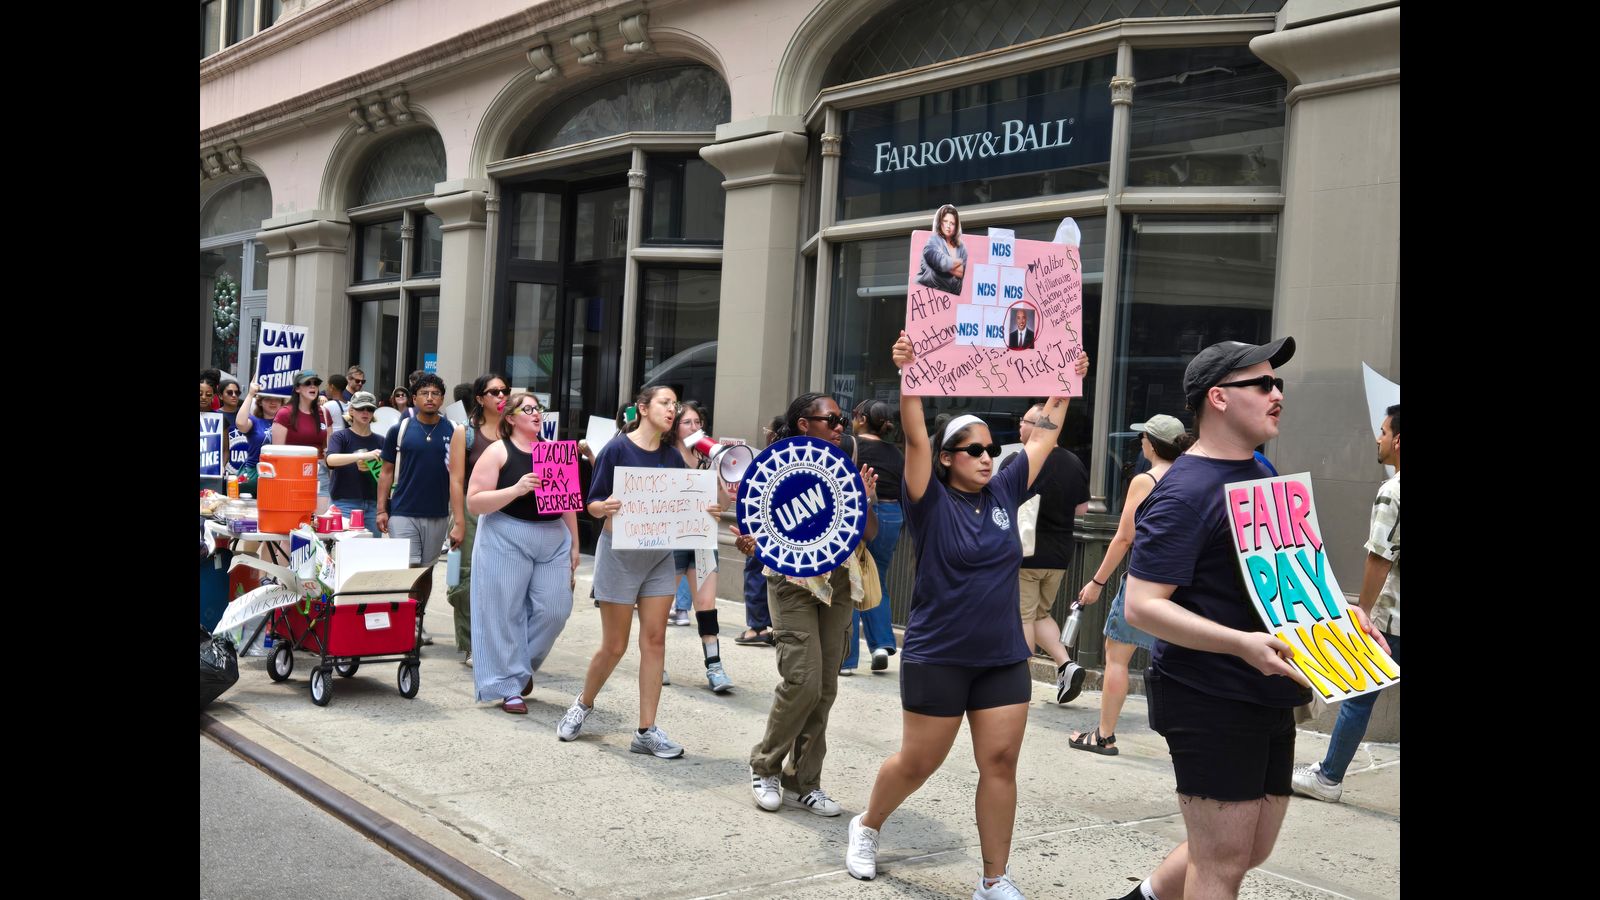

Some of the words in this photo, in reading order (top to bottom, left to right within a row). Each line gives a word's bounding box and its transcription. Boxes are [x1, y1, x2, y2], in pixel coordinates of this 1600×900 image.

[991, 242, 1011, 257] NDS
[1033, 254, 1064, 280] Malibu
[977, 282, 996, 297] NDS
[1004, 285, 1023, 299] NDS
[1036, 273, 1072, 295] Millionaire
[911, 289, 927, 321] At
[925, 287, 951, 315] the
[1040, 291, 1062, 308] taking
[1043, 303, 1062, 318] union
[1060, 293, 1078, 308] jobs
[263, 329, 305, 349] UAW
[958, 322, 979, 336] NDS
[985, 324, 1005, 339] NDS
[907, 324, 958, 357] bottom
[273, 355, 291, 371] ON
[1053, 339, 1082, 369] Jones
[905, 366, 921, 390] of
[916, 358, 947, 383] the
[938, 341, 984, 395] pyramid
[200, 451, 219, 467] IKE
[543, 467, 553, 479] IS
[557, 467, 564, 478] A
[541, 478, 569, 493] PAY
[537, 492, 583, 512] DECREASE
[651, 499, 690, 514] WAGES
[775, 483, 826, 531] UAW
[1229, 480, 1323, 552] FAIR
[1245, 549, 1342, 628] PAY
[1274, 608, 1400, 699] NOW
